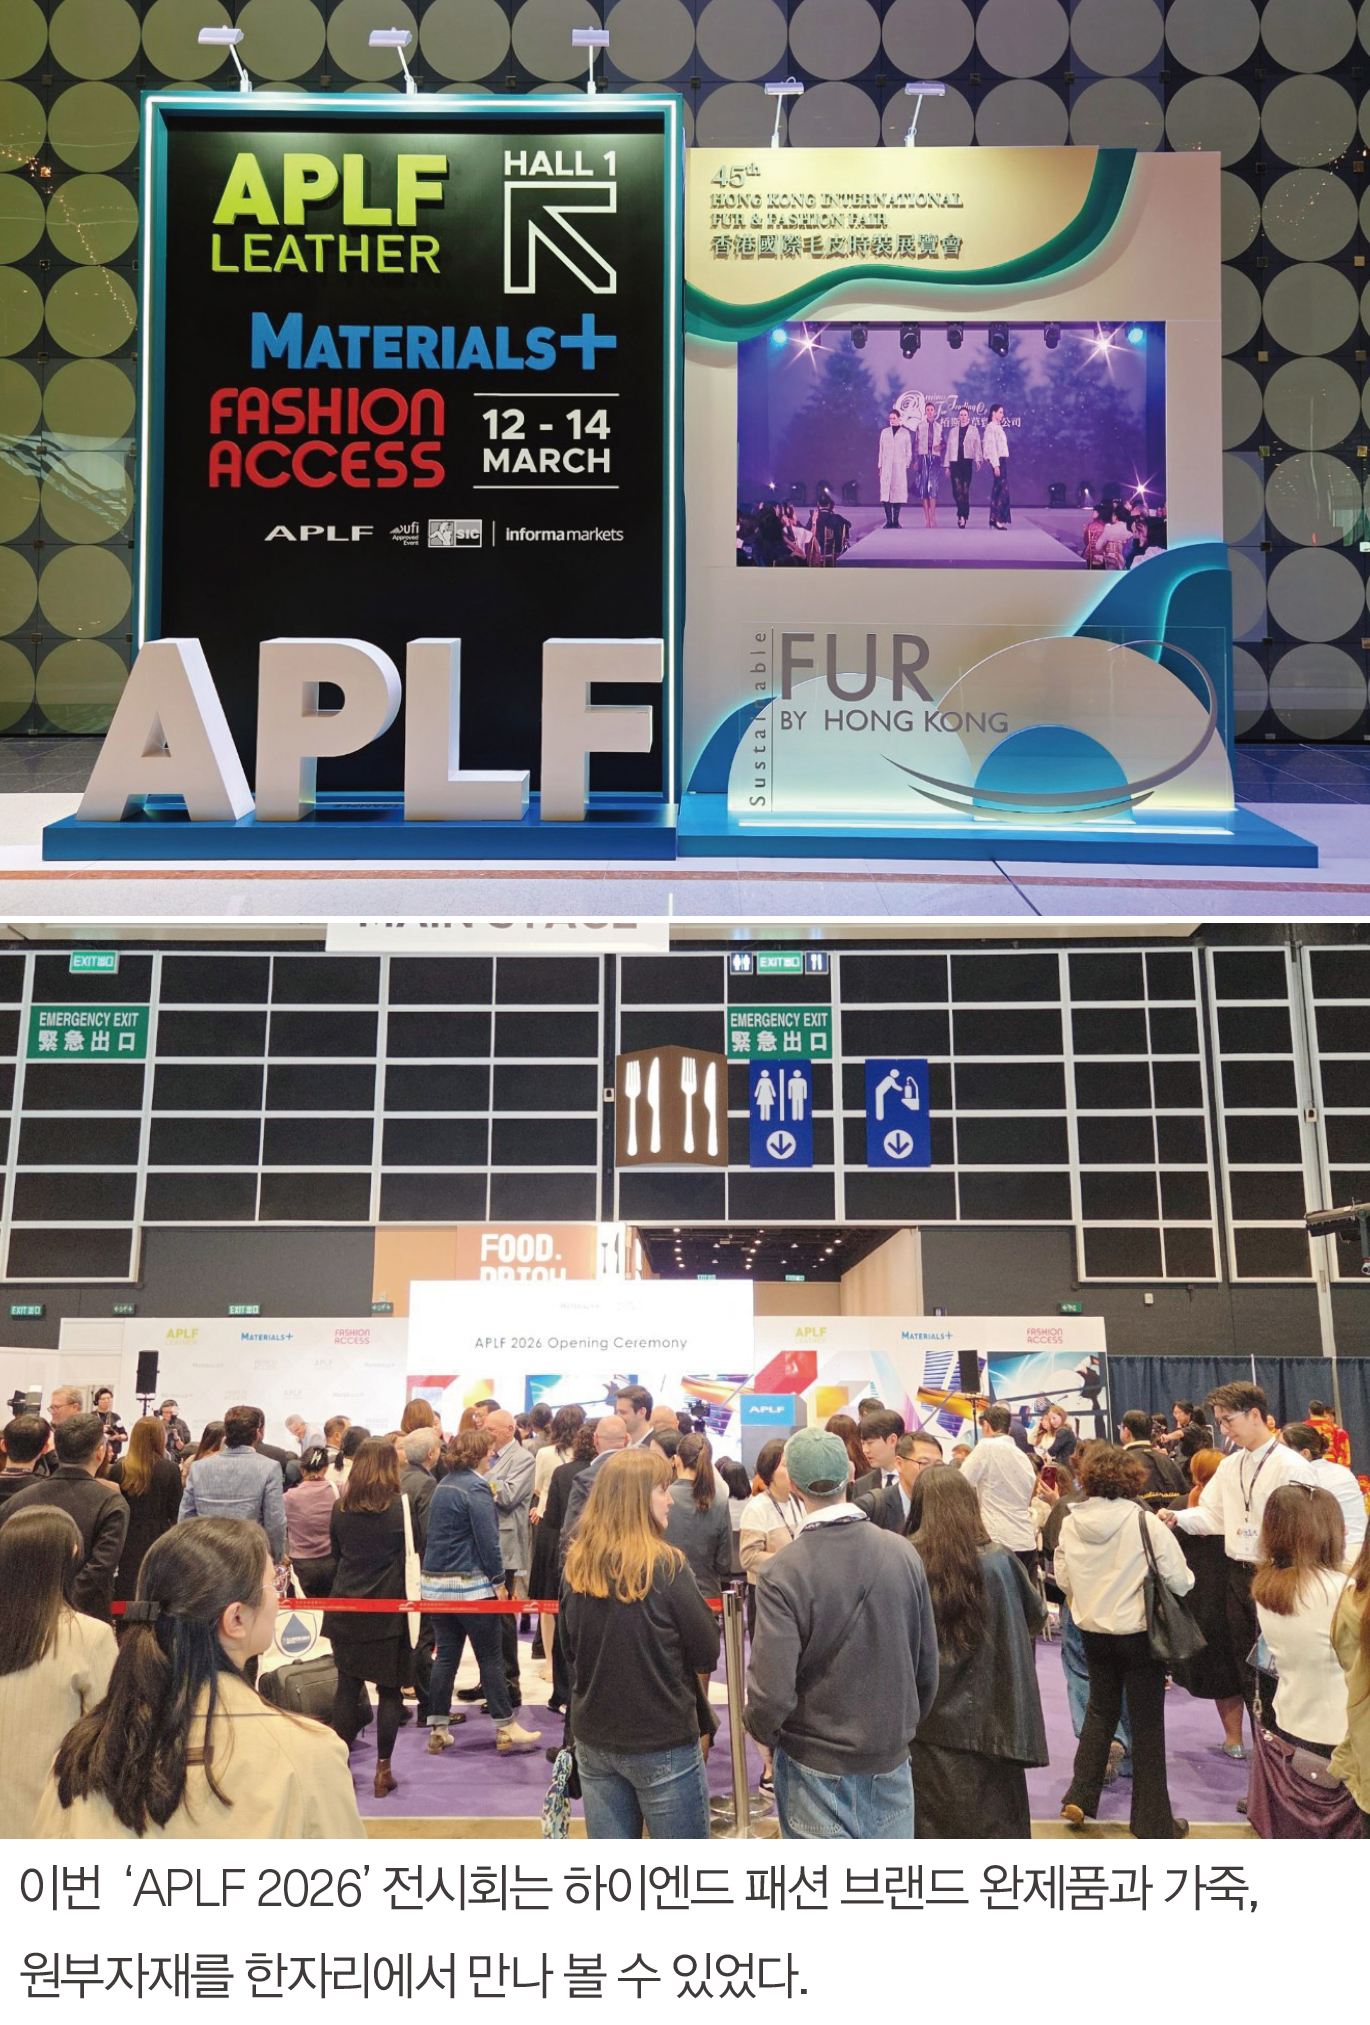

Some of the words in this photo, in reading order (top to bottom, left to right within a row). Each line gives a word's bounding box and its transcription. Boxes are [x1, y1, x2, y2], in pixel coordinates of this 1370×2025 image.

[504, 150, 595, 177] HALL
[603, 150, 617, 175] 1
[710, 163, 761, 188] 45th
[212, 152, 449, 227] APLF
[710, 193, 762, 209] HONG
[766, 193, 817, 209] KONG
[820, 193, 964, 209] INTERNATIONAL
[710, 213, 746, 229] FUR
[750, 213, 763, 229] &
[766, 213, 845, 229] FASHION
[848, 213, 889, 229] FAIR
[211, 233, 441, 274] LEATHER
[712, 233, 963, 260] 香港國際毛皮時裝展覽會
[209, 387, 445, 436] FASHION
[482, 409, 526, 440] 12
[566, 409, 611, 440] 14
[208, 440, 446, 489] ACCESS
[483, 448, 611, 473] MARCH
[264, 525, 374, 541] APLF
[456, 529, 480, 540] SIC
[781, 632, 934, 702] FUR
[750, 632, 766, 806] Sustainable
[781, 711, 807, 730] BY
[824, 710, 914, 732] HONG
[925, 710, 1009, 733] KONG
[74, 637, 665, 822] APLF
[73, 955, 97, 967] EXIT
[760, 957, 782, 967] EXIT
[39, 1012, 111, 1027] EMERGENCY
[113, 1012, 139, 1027] EXIT
[730, 1013, 801, 1027] EMERGENCY
[803, 1013, 828, 1026] EXIT
[38, 1030, 136, 1052] 緊急出口
[731, 1030, 828, 1052] 緊急出口
[480, 1233, 562, 1263] FOOD.
[12, 1305, 27, 1315] EXIT
[229, 1305, 245, 1314] EXIT
[166, 1328, 200, 1339] APLF
[334, 1328, 371, 1337] FASHION
[795, 1327, 827, 1338] APLF
[1026, 1328, 1063, 1336] FASHION
[1027, 1336, 1063, 1344] ACCESS
[334, 1337, 371, 1345] ACCESS
[475, 1337, 507, 1349] APLF
[511, 1337, 542, 1349] 2026
[547, 1336, 609, 1351] Opening
[613, 1337, 688, 1351] Ceremony
[749, 1405, 785, 1413] APLF
